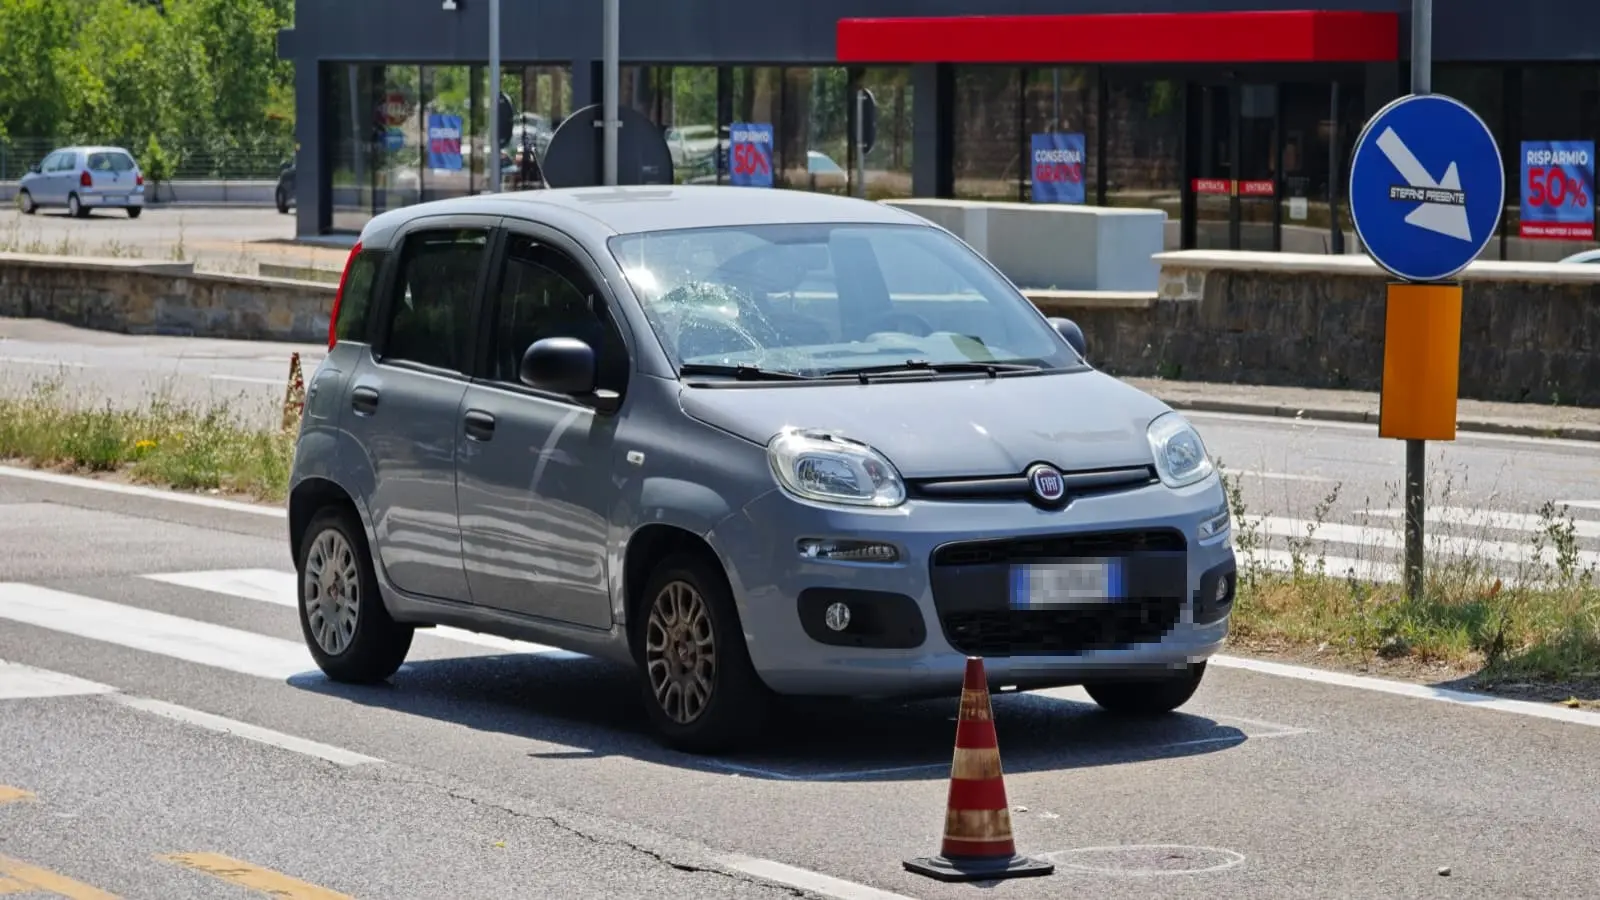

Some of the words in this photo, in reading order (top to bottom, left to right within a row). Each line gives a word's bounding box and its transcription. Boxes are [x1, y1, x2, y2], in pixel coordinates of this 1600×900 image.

[1035, 149, 1081, 163] CONSEGNA
[1527, 150, 1588, 165] RISPARMIO
[1245, 182, 1274, 192] ENTRATA
[1527, 166, 1588, 208] 50%
[1390, 187, 1425, 200] STEFANO
[1426, 190, 1465, 204] PRESENTE
[1040, 476, 1058, 492] FIAT
